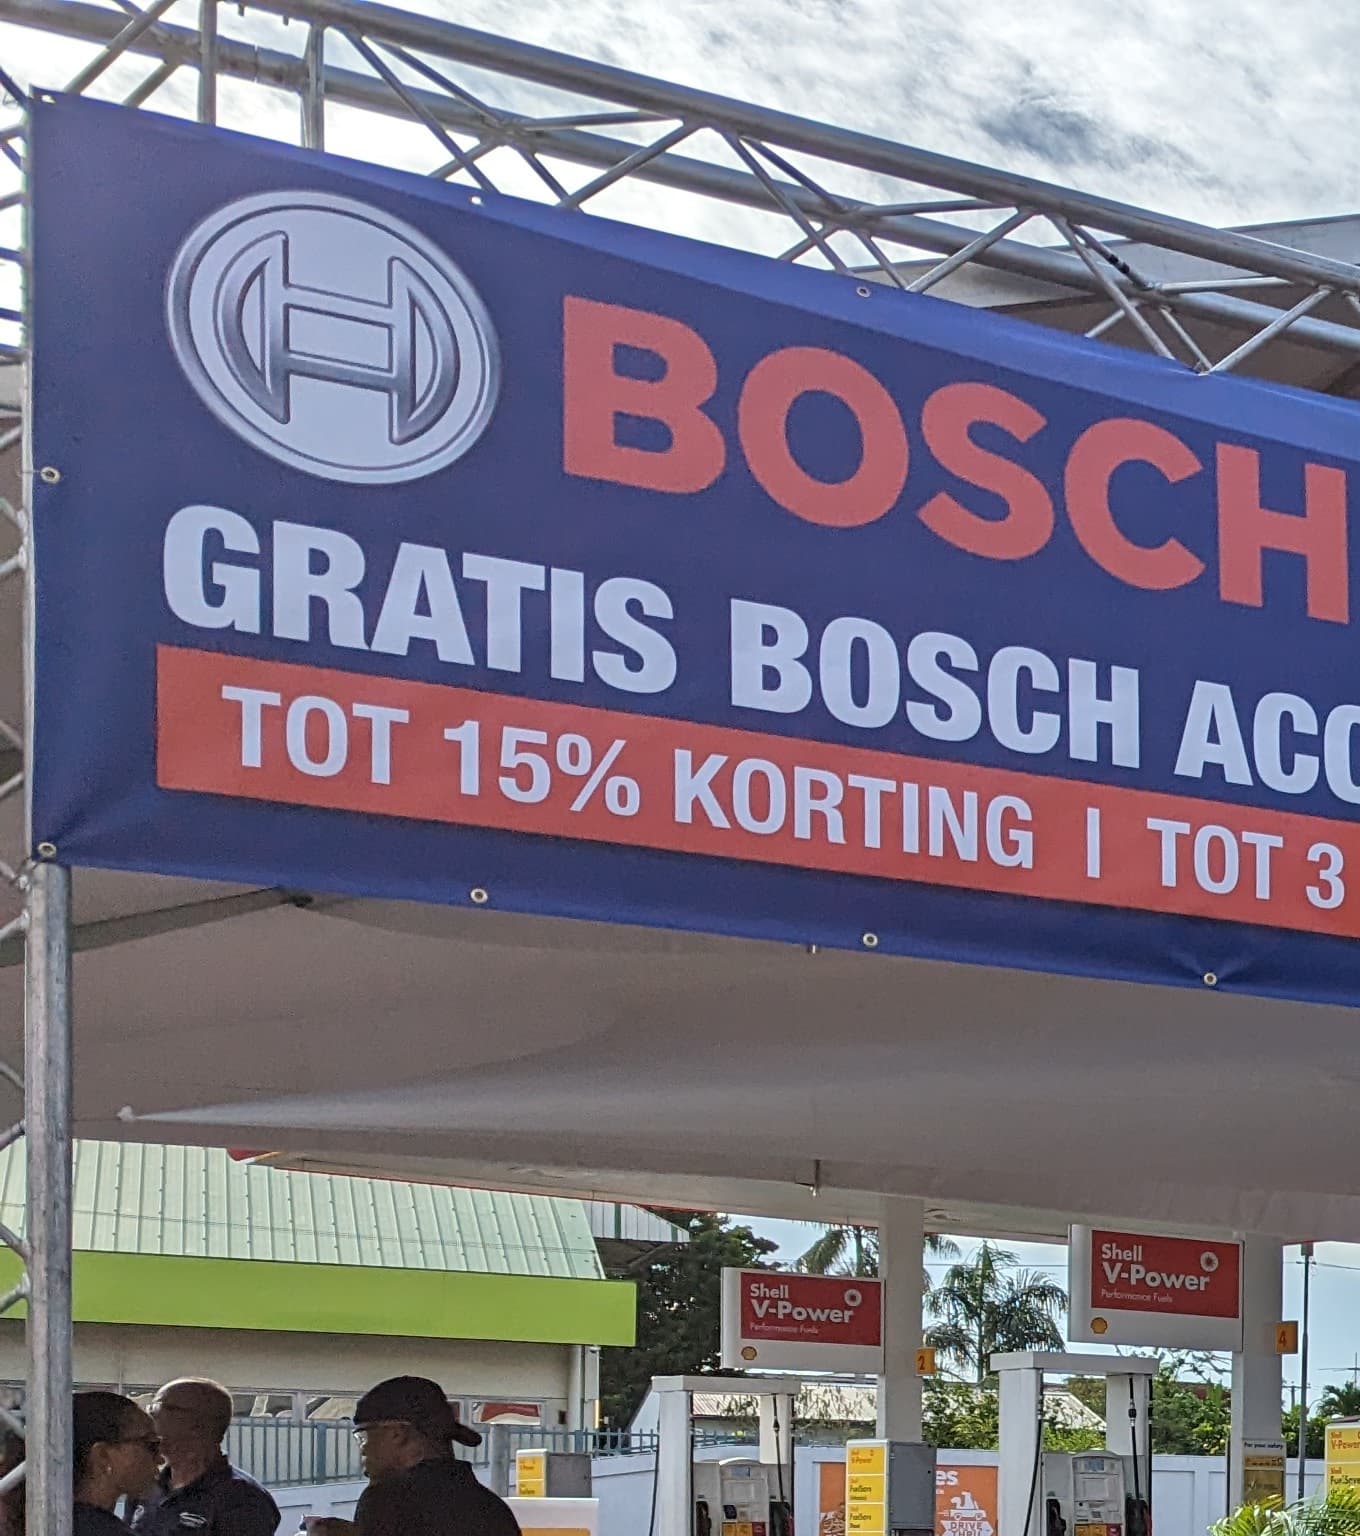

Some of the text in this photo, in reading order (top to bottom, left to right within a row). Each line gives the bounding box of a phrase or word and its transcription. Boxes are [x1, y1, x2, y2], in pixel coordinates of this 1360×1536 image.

[562, 294, 1349, 624] BOSCH
[162, 504, 677, 694] GRATIS
[730, 598, 1139, 769] BOSCH
[222, 686, 409, 786] TOT
[444, 720, 641, 816] 15%
[674, 748, 1034, 870] KORTING
[1147, 818, 1283, 900] TOT
[1307, 842, 1346, 909] 3
[1101, 1243, 1143, 1262] Shell
[1102, 1261, 1210, 1291] V-Power
[750, 1283, 789, 1299] Shell
[750, 1299, 854, 1324] V-Power
[1277, 1331, 1287, 1347] 4
[950, 1521, 983, 1530] DRIVE
